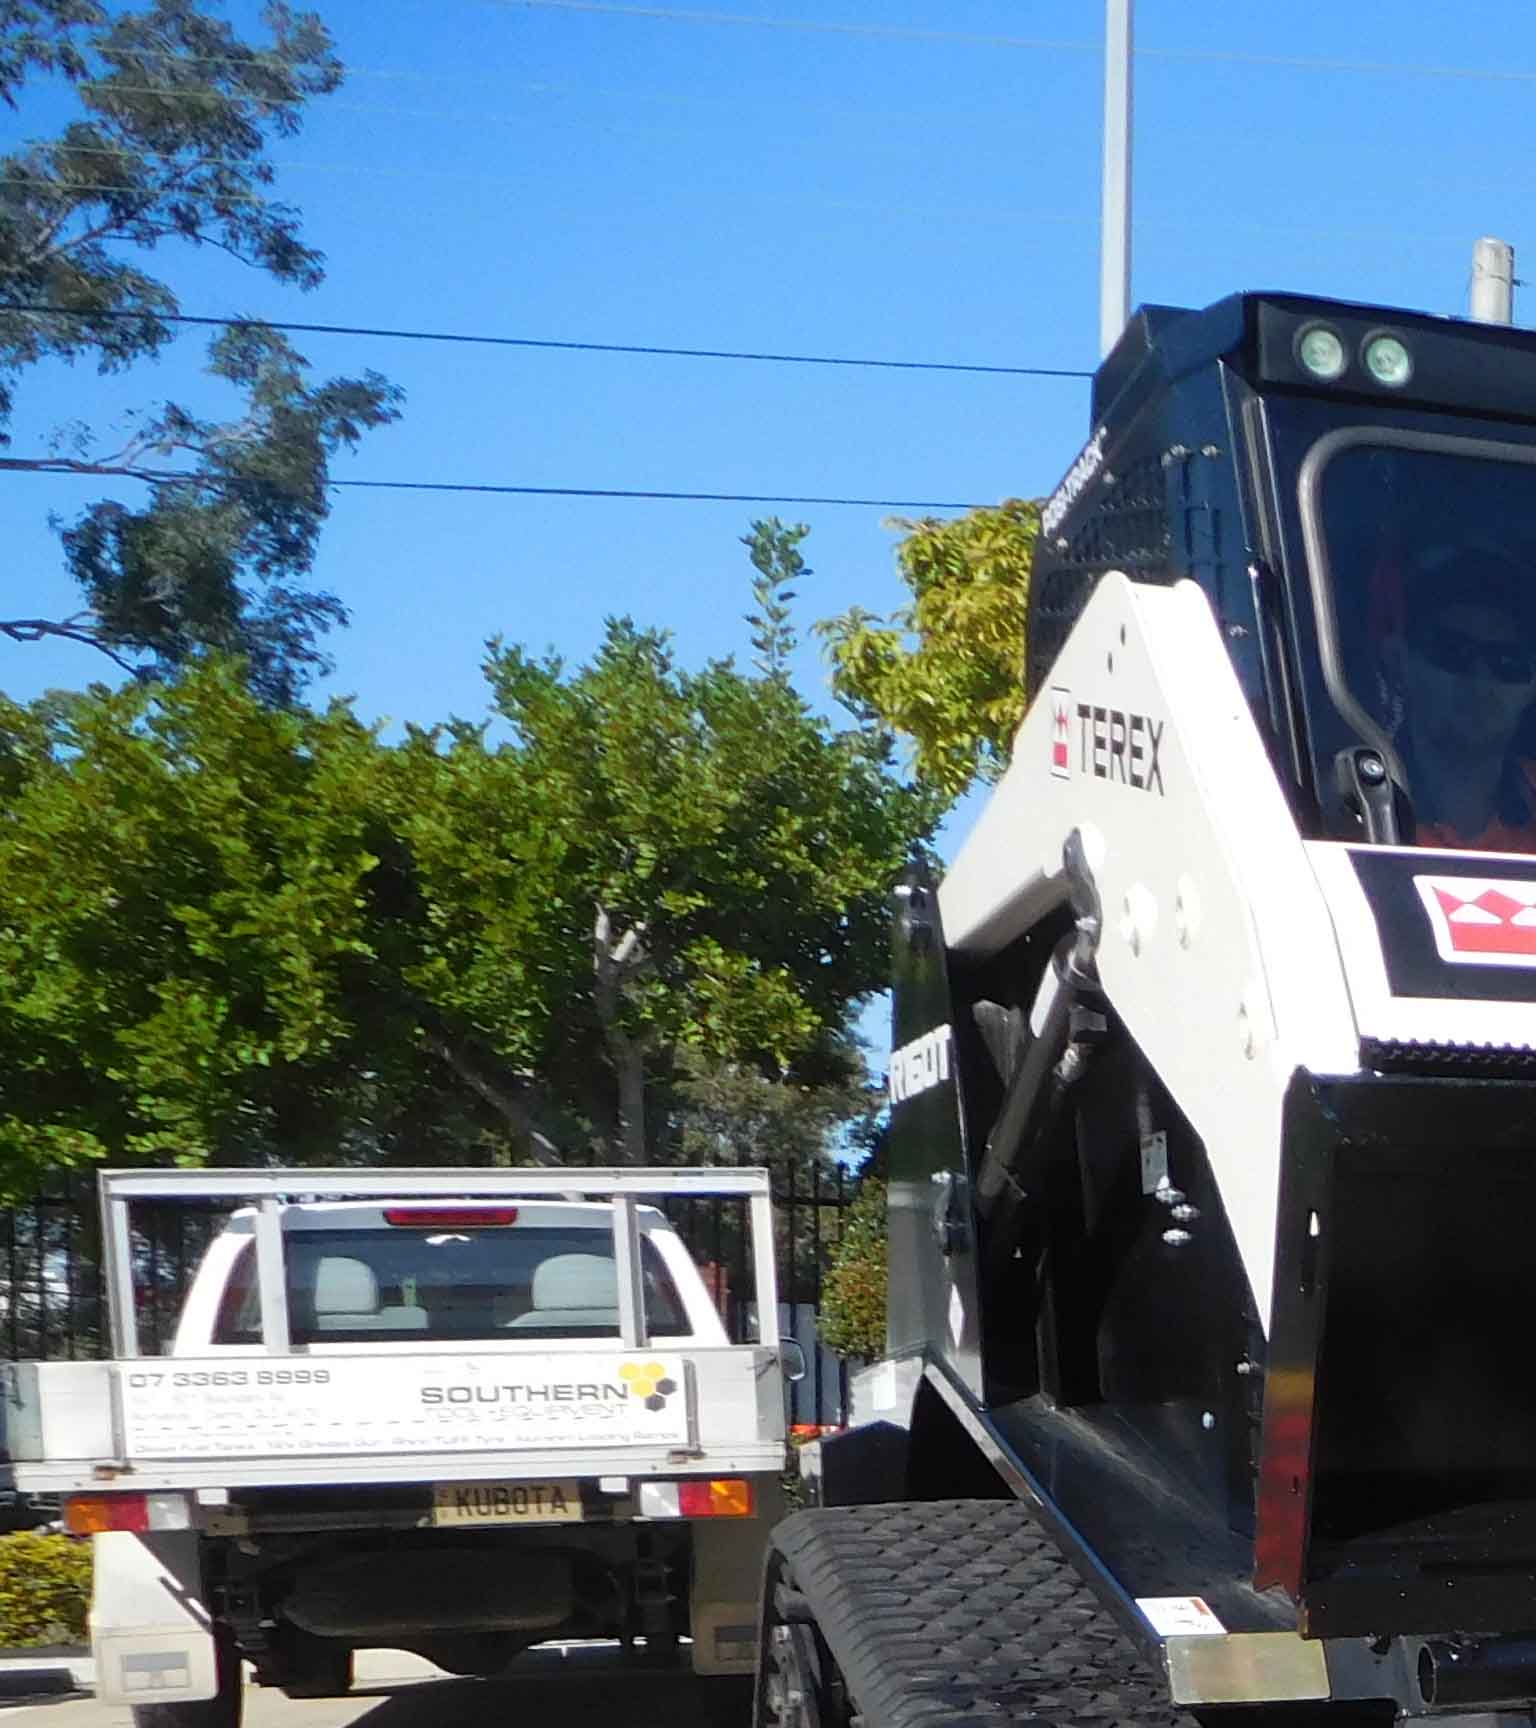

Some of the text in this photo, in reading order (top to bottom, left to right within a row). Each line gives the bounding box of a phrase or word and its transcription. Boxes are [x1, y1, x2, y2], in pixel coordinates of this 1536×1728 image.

[1077, 703, 1165, 797] TEREX
[128, 1373, 165, 1388] 07
[173, 1370, 249, 1387] 3363
[421, 1383, 629, 1405] SOUTHERN
[424, 1406, 481, 1420] TOOL
[499, 1403, 630, 1418] EQUIPMENT
[455, 1485, 569, 1517] KUBOTA
